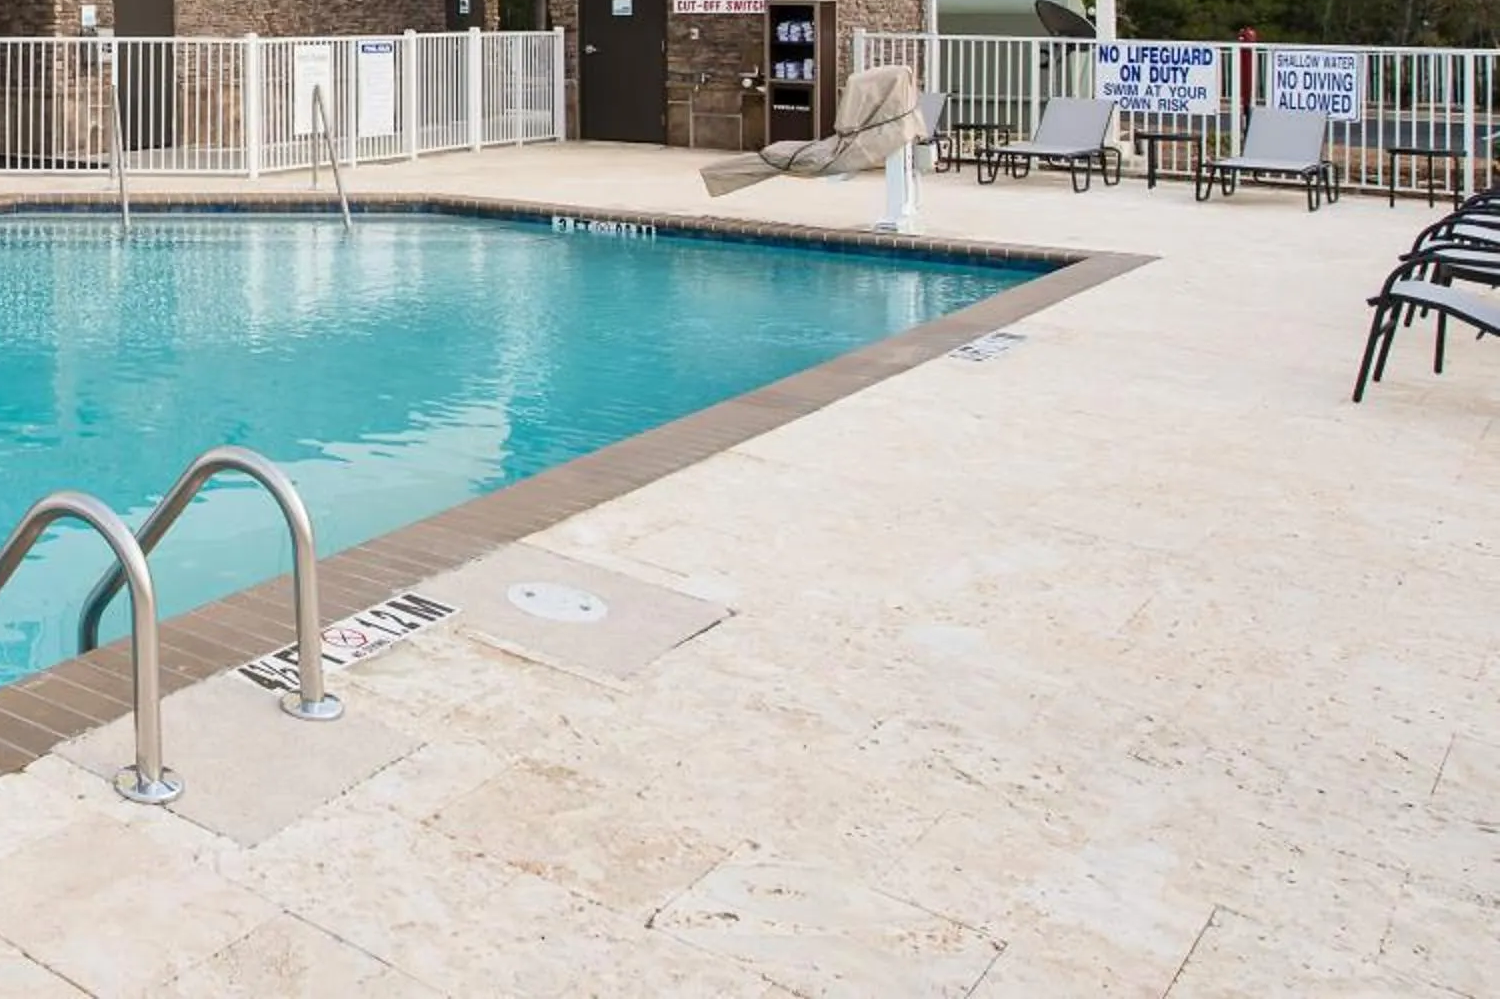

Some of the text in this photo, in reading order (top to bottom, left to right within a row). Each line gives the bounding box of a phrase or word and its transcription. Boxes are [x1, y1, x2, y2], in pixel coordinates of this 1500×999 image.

[678, 1, 720, 11] CUT-OFF
[1099, 46, 1213, 66] NO LIFEGUARD
[1277, 54, 1355, 69] SHALLOW WATER
[1120, 65, 1190, 84] ON DUTY
[1277, 71, 1353, 92] NO DIVING
[1103, 83, 1207, 100] SWIM AT YOUR
[1120, 97, 1189, 112] OWN RISK
[1278, 91, 1352, 114] ALLOWED
